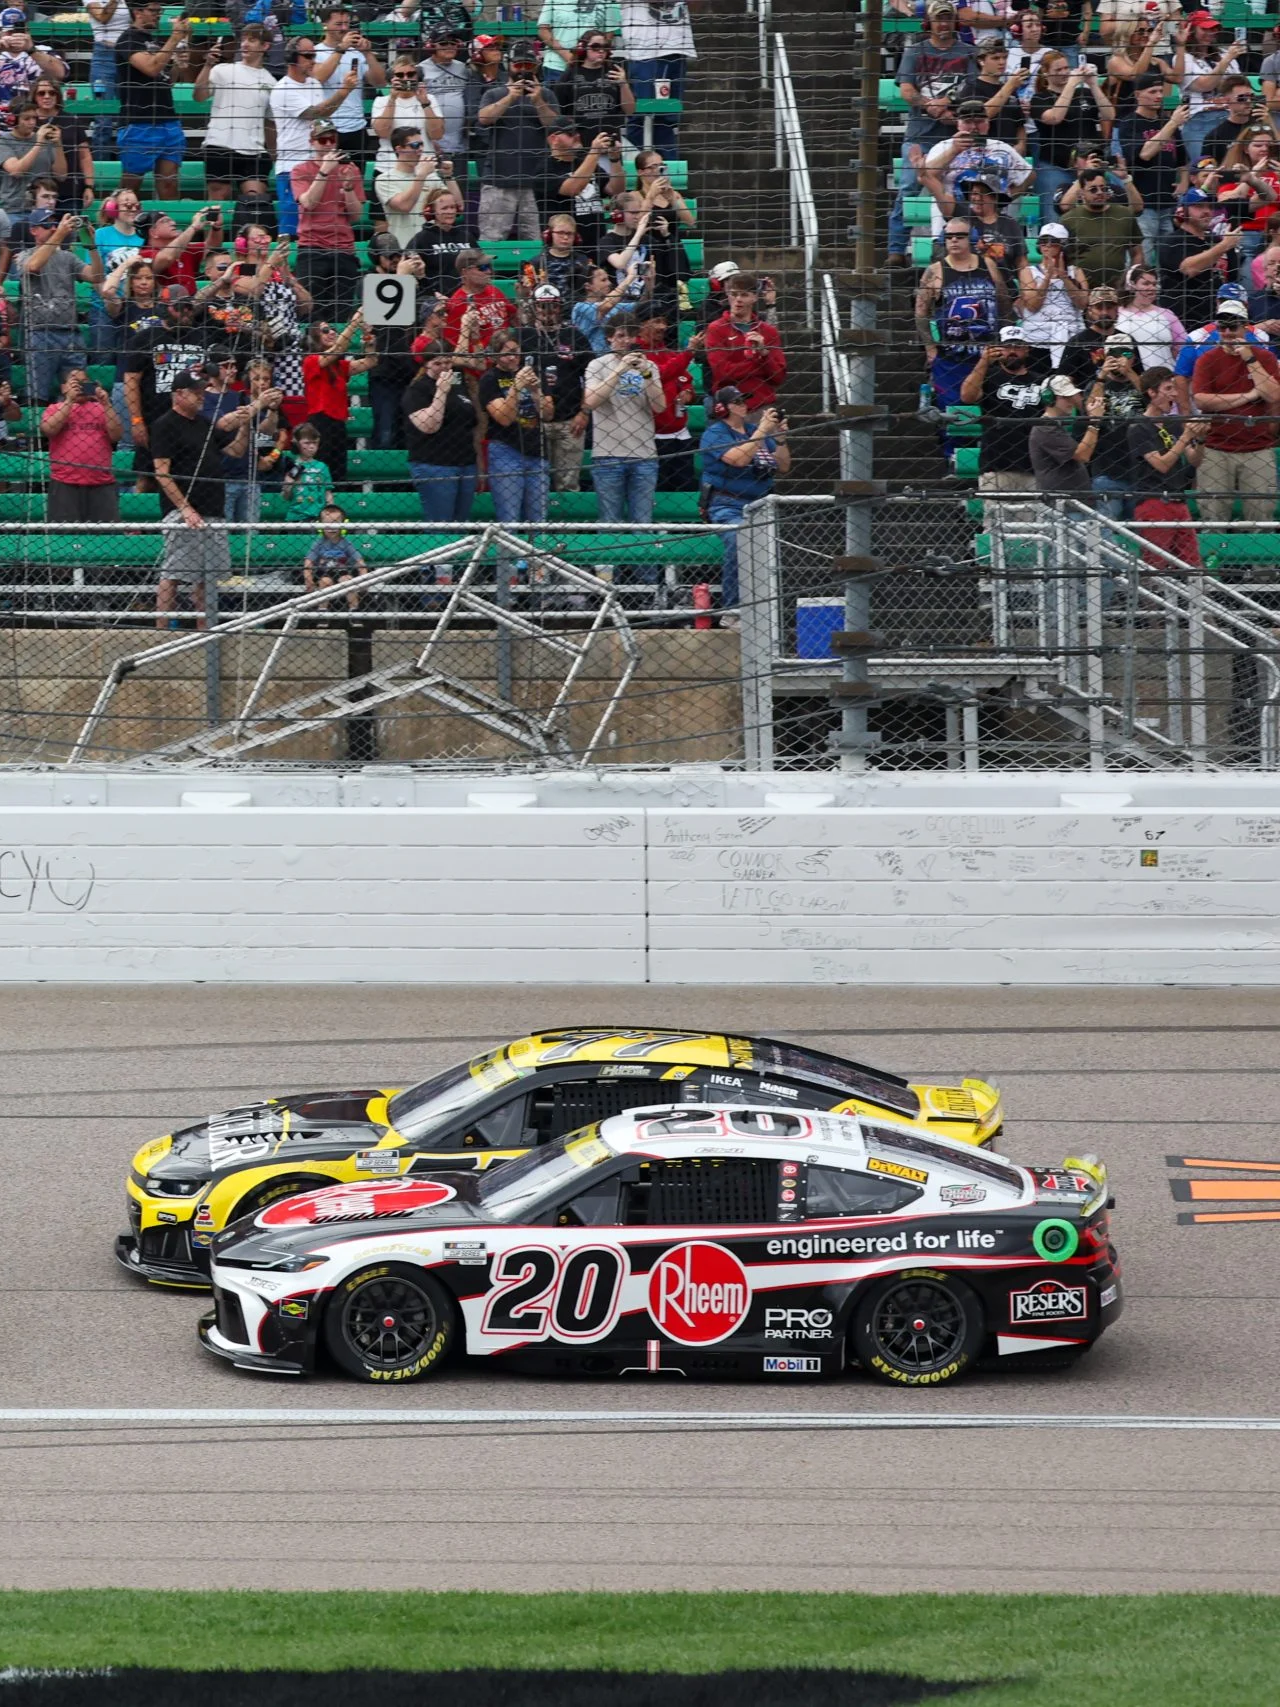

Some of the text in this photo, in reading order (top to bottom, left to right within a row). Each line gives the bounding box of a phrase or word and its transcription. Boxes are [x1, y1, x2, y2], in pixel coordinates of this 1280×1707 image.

[376, 279, 403, 321] 9
[710, 1074, 744, 1088] IKEA
[767, 1229, 908, 1258] engineered
[913, 1231, 947, 1249] for
[345, 1267, 391, 1292] EAGLE
[485, 1247, 623, 1334] 20
[658, 1245, 744, 1328] Rheem
[765, 1307, 834, 1328] PRO
[765, 1329, 834, 1339] PARTNER
[764, 1358, 817, 1371] Mobil 1
